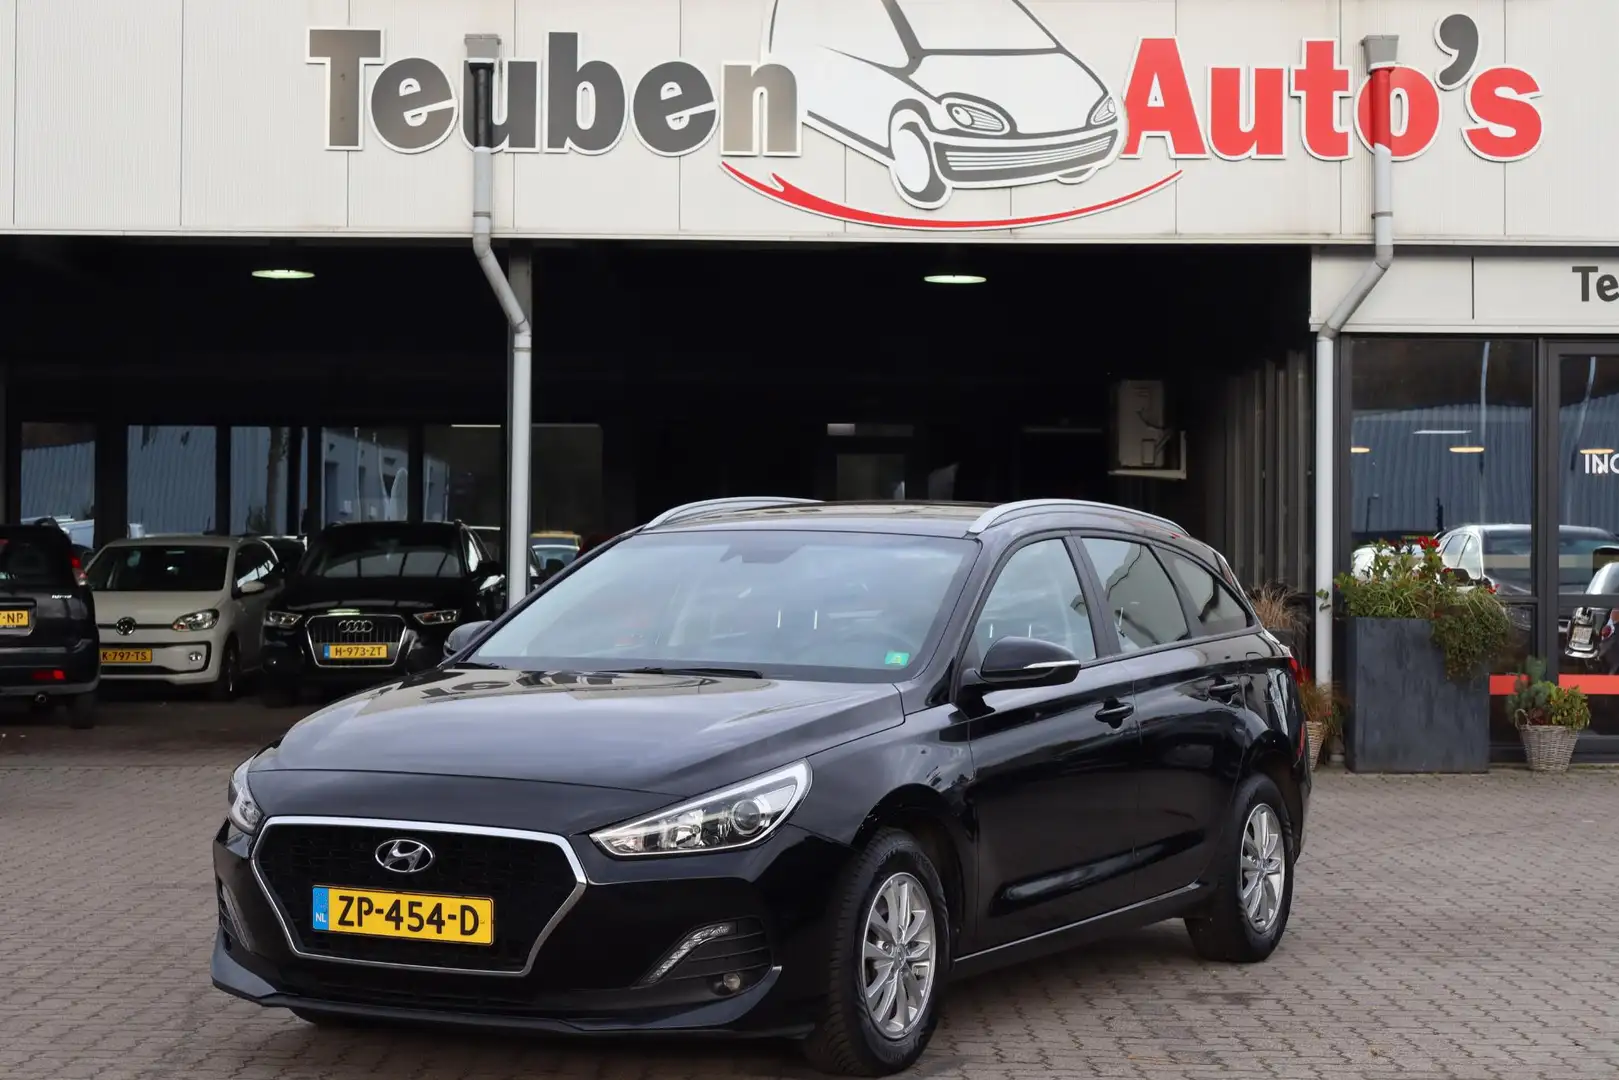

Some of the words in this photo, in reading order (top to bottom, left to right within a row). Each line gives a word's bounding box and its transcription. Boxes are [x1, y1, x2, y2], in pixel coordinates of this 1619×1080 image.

[307, 29, 799, 155] Teuben
[1121, 13, 1543, 160] Auto's
[1571, 265, 1619, 302] Te
[335, 646, 382, 656] H-973-ZT
[315, 912, 327, 923] NL
[337, 895, 480, 936] ZP-454-D
